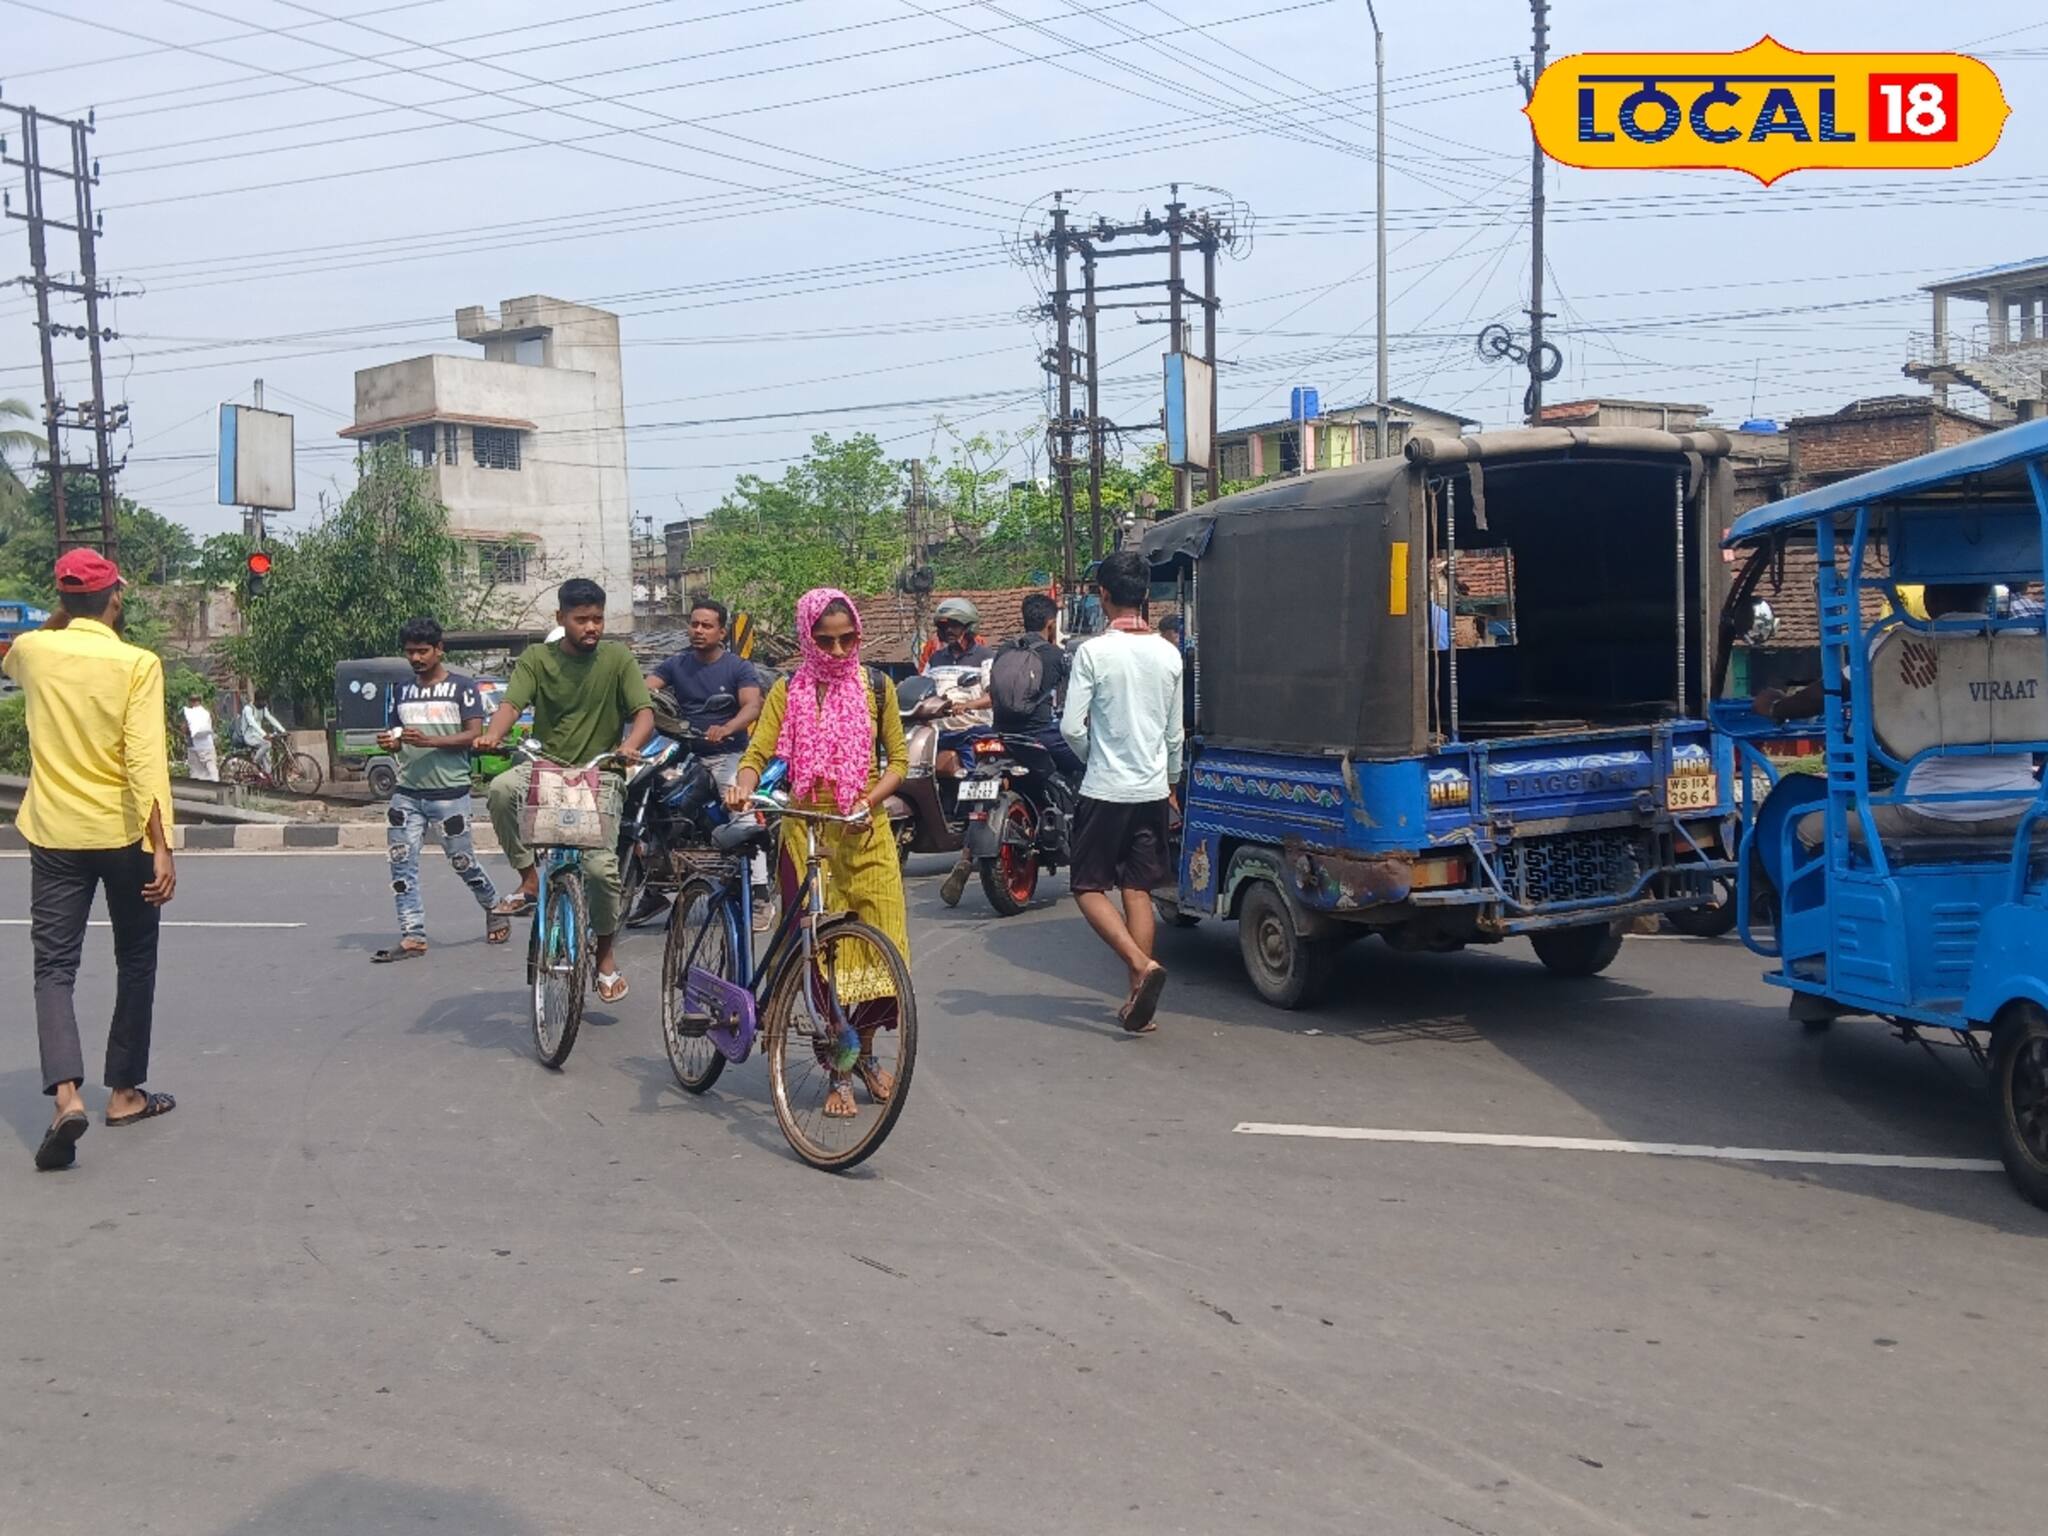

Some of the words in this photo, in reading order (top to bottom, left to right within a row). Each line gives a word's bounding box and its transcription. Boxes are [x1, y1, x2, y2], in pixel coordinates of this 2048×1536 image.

[1968, 679, 2039, 702] VIRAAT
[1504, 769, 1603, 798] PIAGGIO
[1670, 789, 1710, 807] 3964
